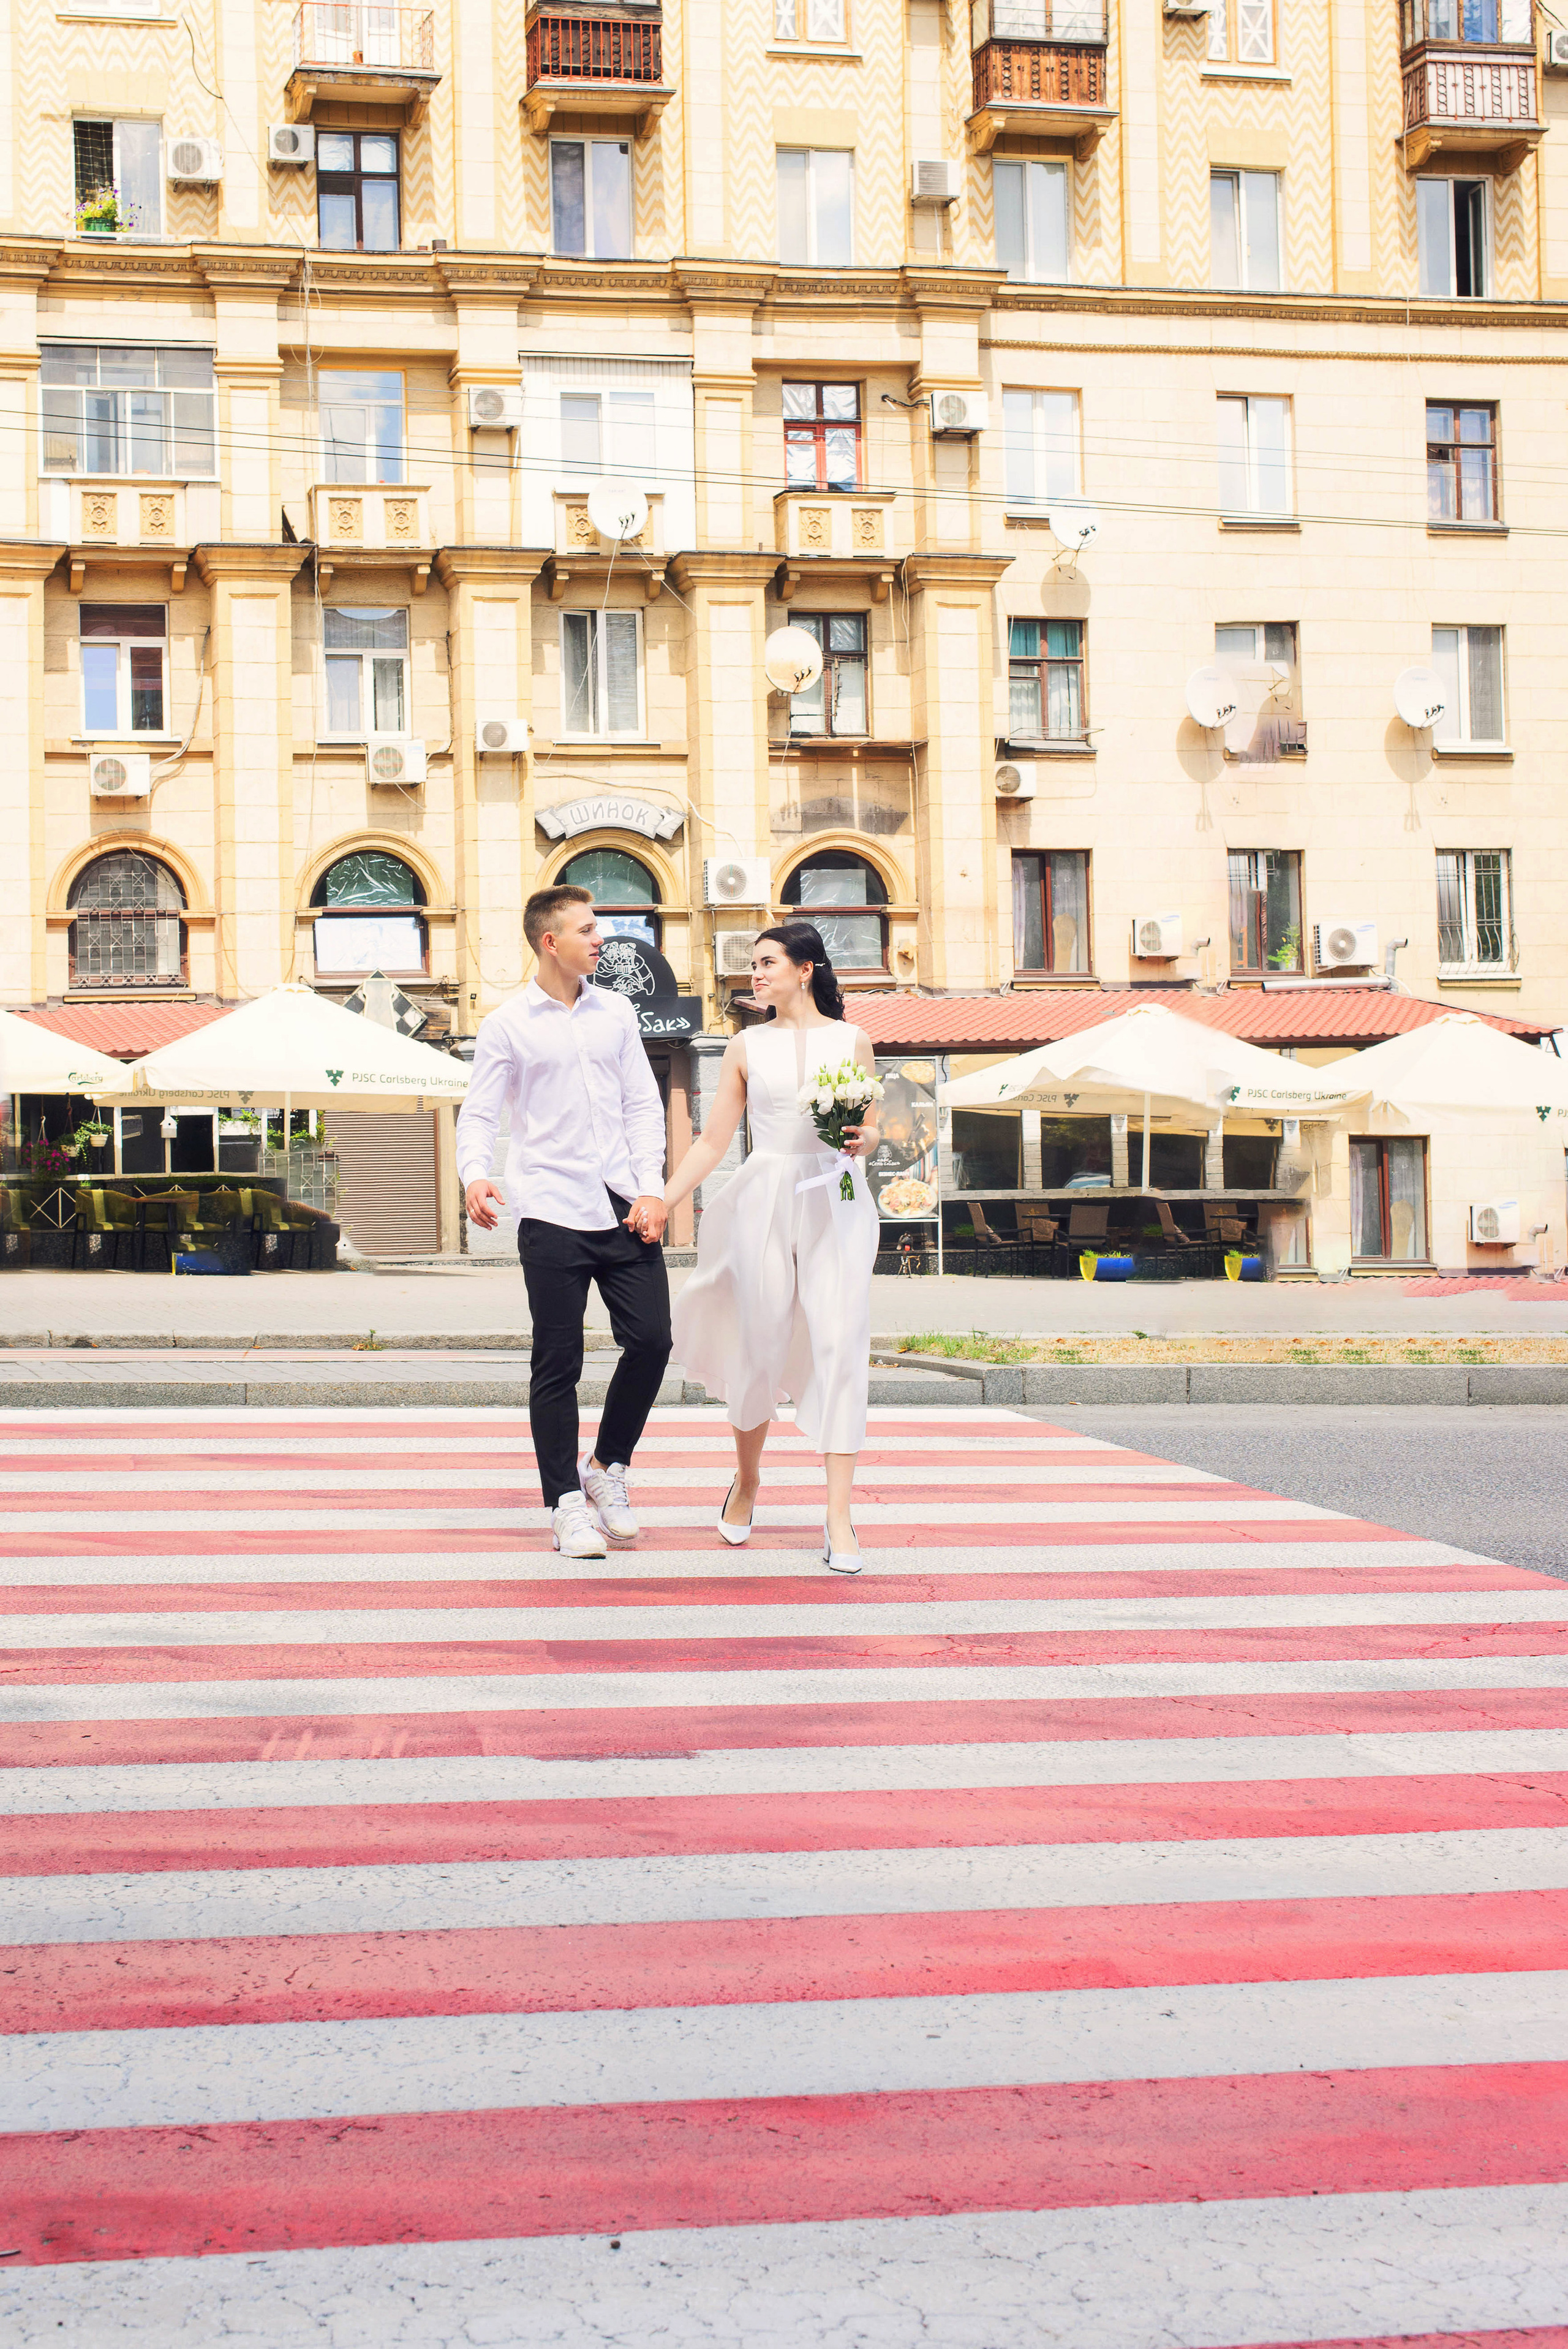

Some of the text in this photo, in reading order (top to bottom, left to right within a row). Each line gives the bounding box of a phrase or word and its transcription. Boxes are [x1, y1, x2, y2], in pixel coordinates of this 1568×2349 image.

[570, 801, 649, 826] ШИНОК
[68, 1072, 104, 1086] Carlsberg
[352, 1073, 469, 1088] PJSC Carlsberg Ukraine
[1248, 1089, 1347, 1102] PJSC Carlsberg Ukraine
